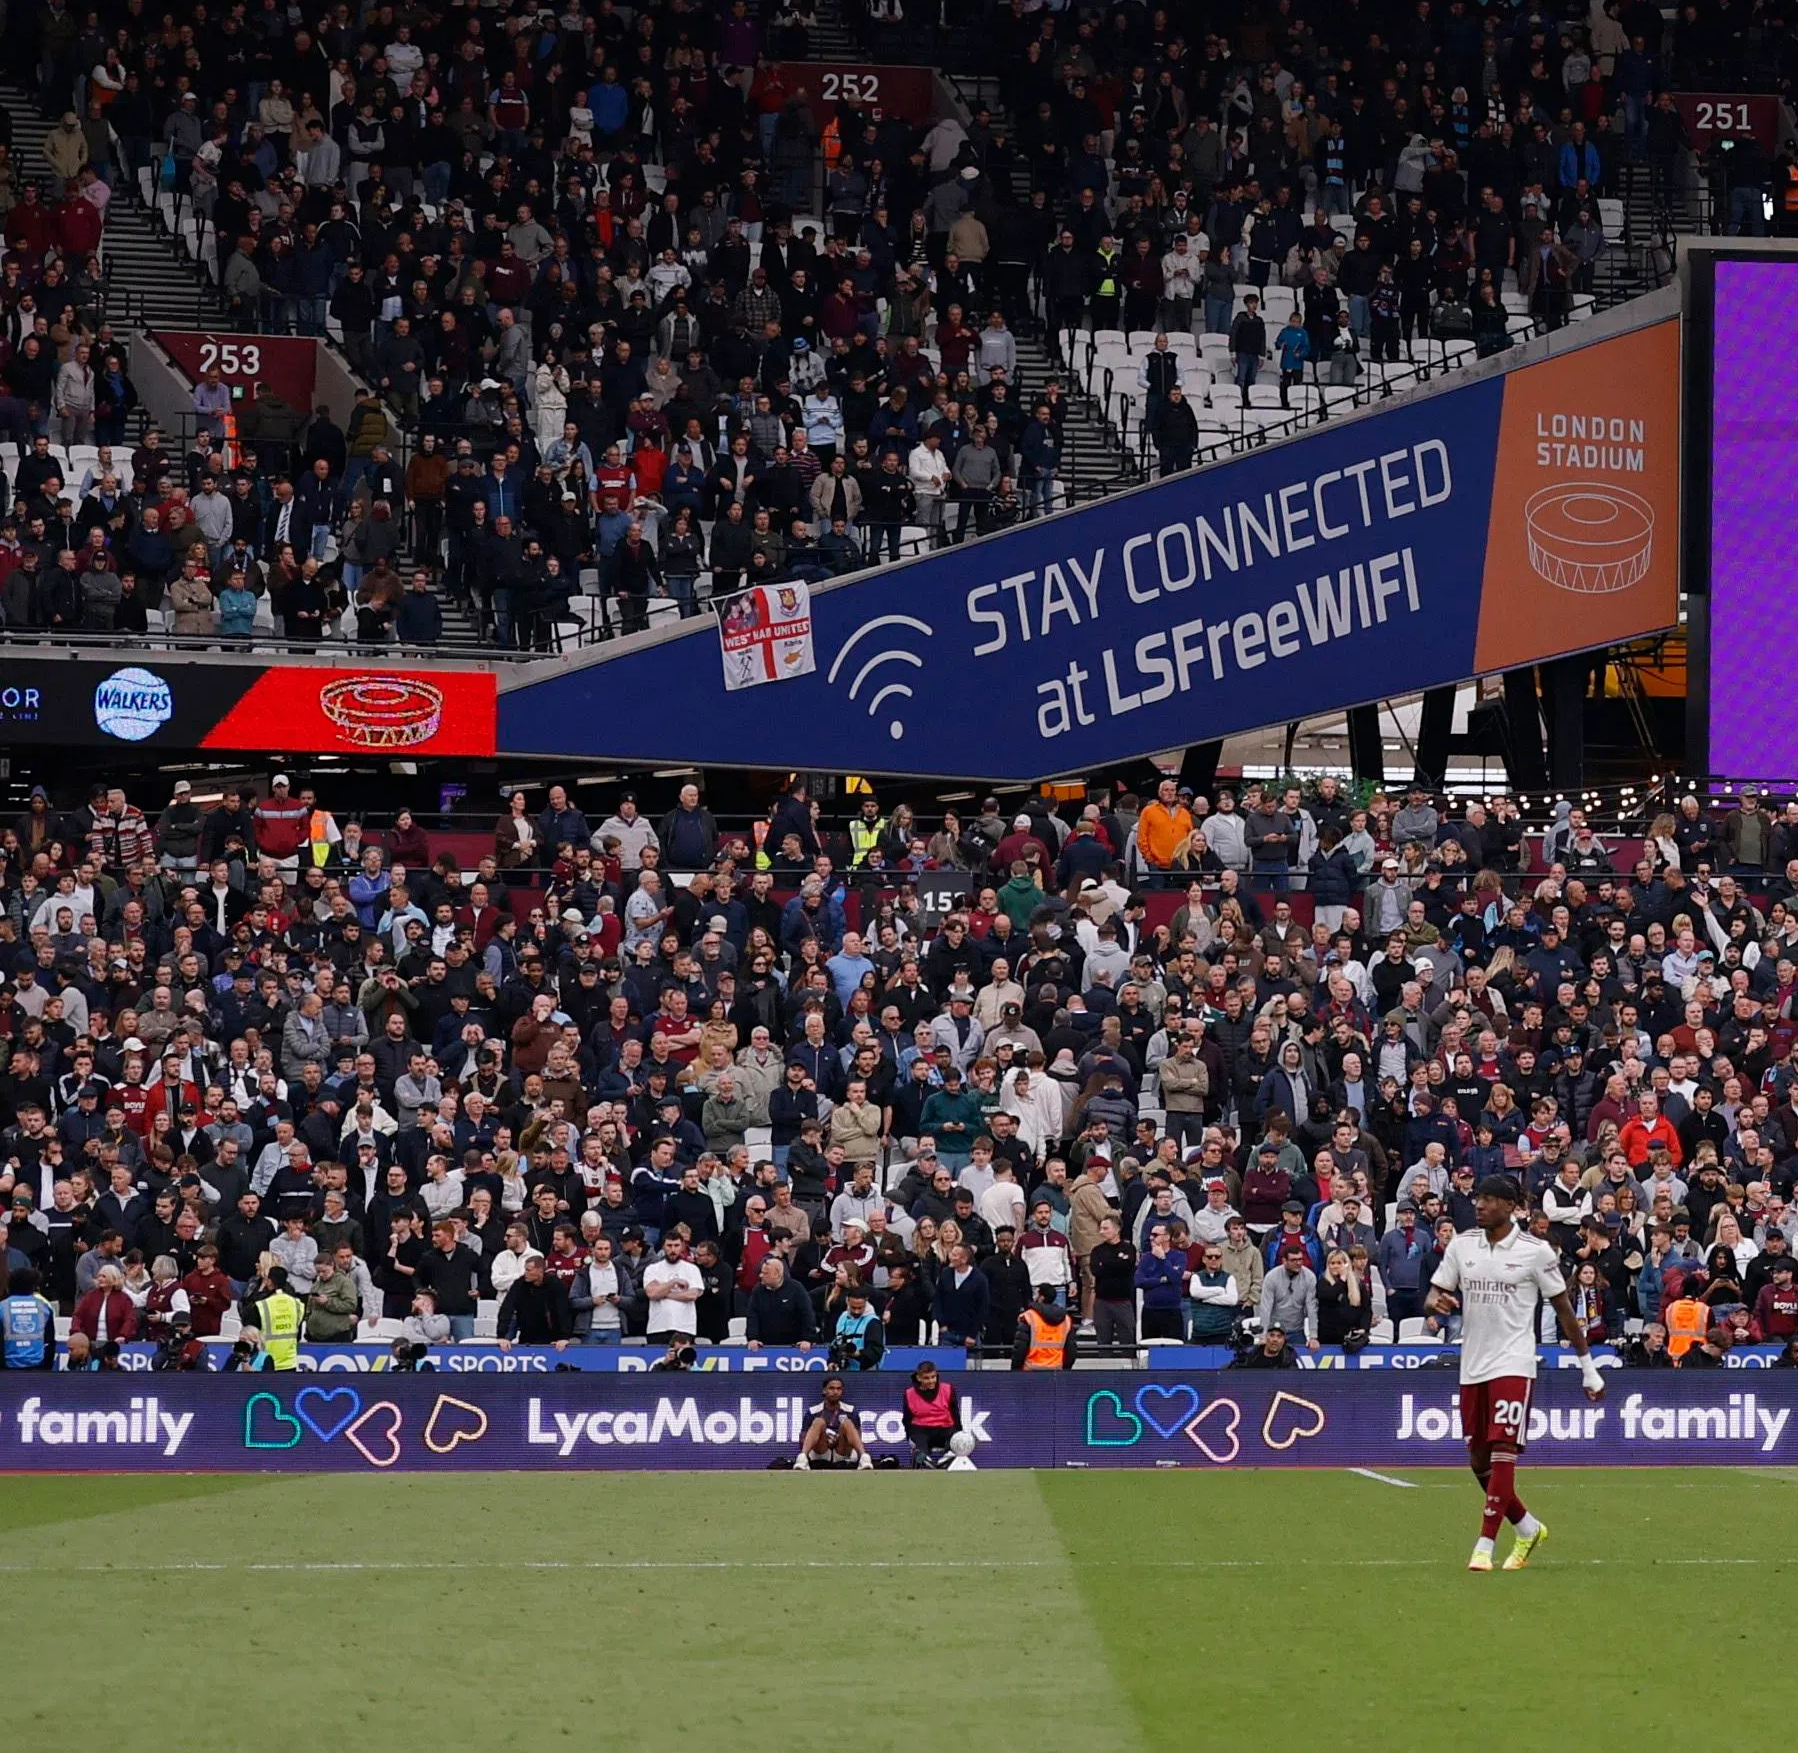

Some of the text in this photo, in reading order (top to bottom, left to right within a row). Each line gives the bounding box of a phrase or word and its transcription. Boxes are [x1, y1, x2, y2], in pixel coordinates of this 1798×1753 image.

[822, 73, 879, 102] 252
[1696, 103, 1752, 131] 251
[199, 343, 261, 375] 253
[1537, 413, 1645, 443] LONDON
[1536, 443, 1645, 472] STADIUM
[966, 437, 1453, 657] STAY CONNECTED
[1036, 547, 1421, 739] at LSFreeWIFI
[99, 689, 169, 712] WALKERS
[923, 891, 966, 913] 15
[1464, 1277, 1518, 1293] Emirates
[17, 1397, 195, 1456] family
[1494, 1400, 1523, 1425] 20
[1621, 1393, 1790, 1452] family
